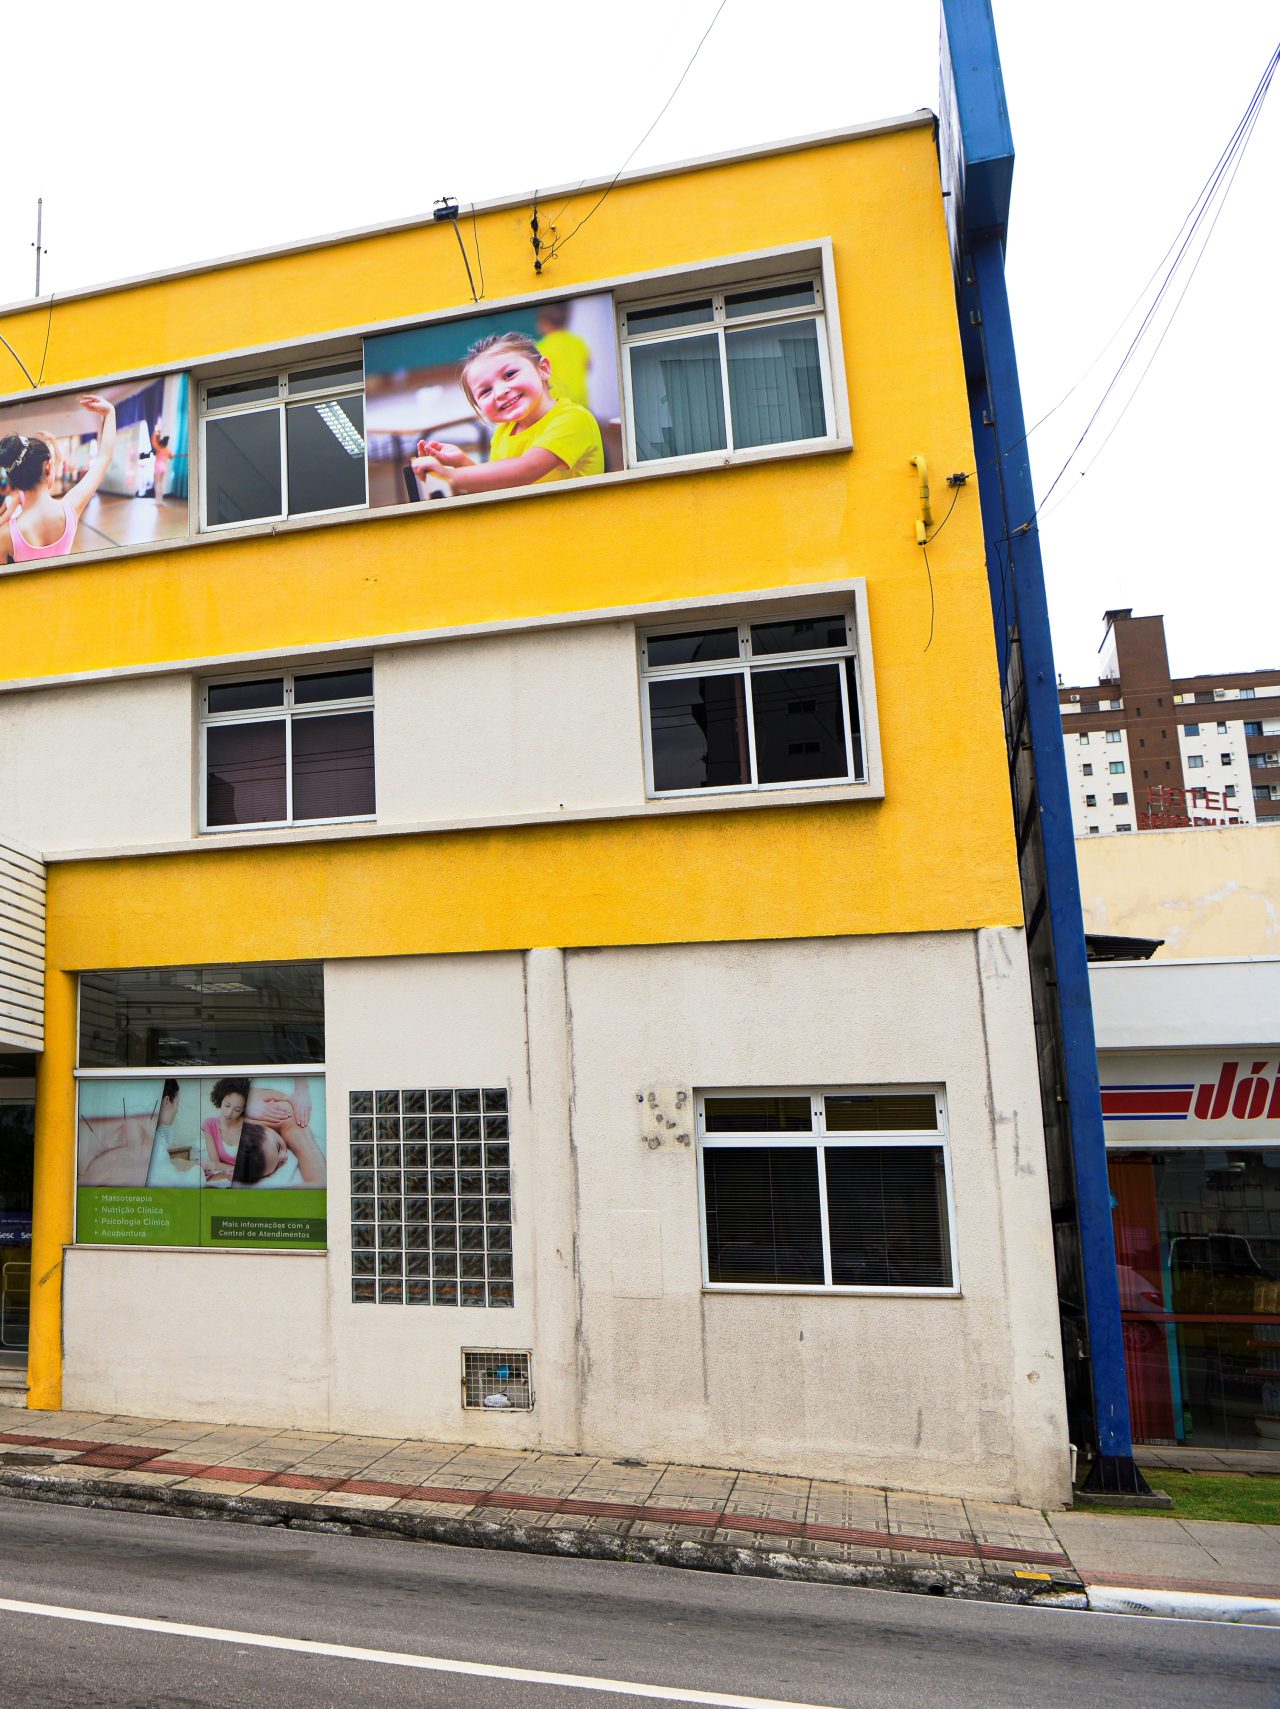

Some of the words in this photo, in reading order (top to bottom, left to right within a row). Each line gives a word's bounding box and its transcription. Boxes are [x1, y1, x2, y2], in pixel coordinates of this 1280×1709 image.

[1148, 785, 1239, 812] HOTEL
[101, 1195, 152, 1203] Massoterapia
[101, 1206, 135, 1214] Nutrição
[137, 1206, 163, 1214] Clínica
[101, 1218, 140, 1226] Psicologia
[144, 1218, 169, 1226] Clínica
[240, 1221, 285, 1229] informações
[258, 1230, 310, 1238] Atendimentos
